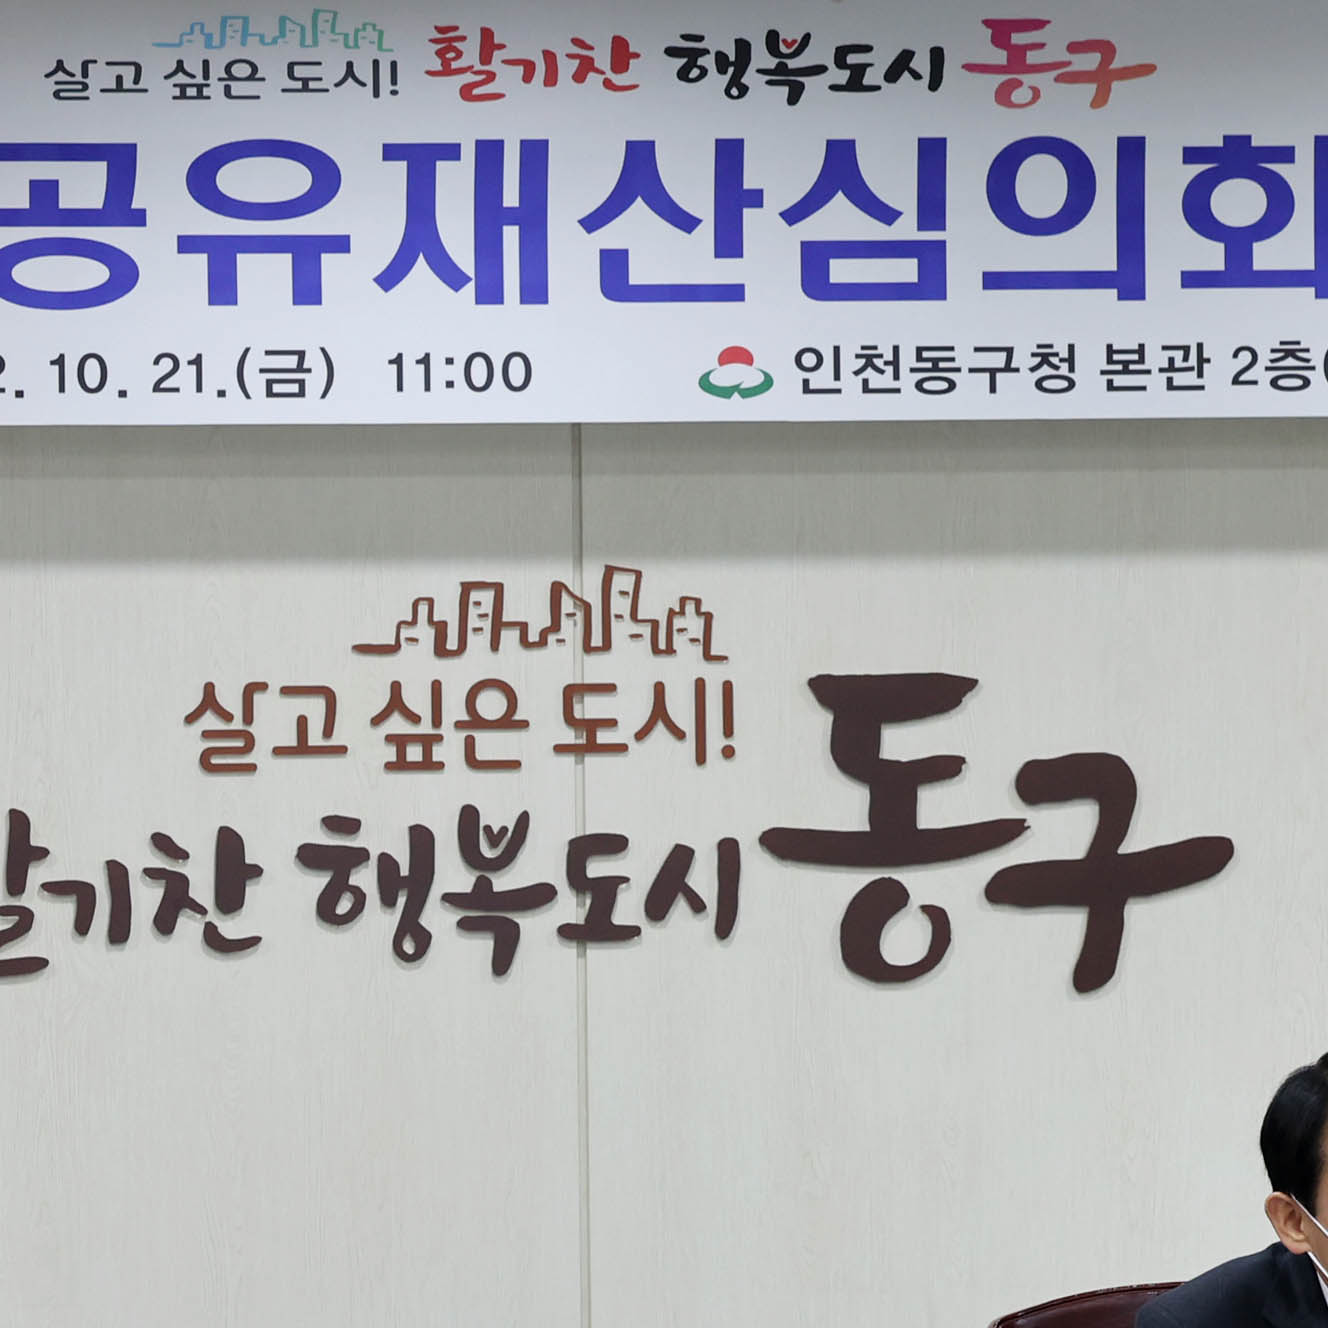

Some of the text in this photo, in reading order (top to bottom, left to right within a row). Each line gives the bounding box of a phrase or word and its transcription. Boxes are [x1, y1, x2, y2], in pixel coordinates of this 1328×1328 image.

[43, 17, 1158, 109] 살고 싶은 도시! 활기찬 행복도시 동구
[48, 351, 129, 399] 10.
[150, 346, 336, 401] 21.(금)
[386, 350, 534, 394] 11:00
[793, 341, 1078, 397] 인천동구청
[1098, 340, 1213, 394] 본관
[183, 676, 738, 776] 살고 싶은 도시!
[293, 802, 743, 979] 행복도시
[756, 670, 1236, 996] 동구
